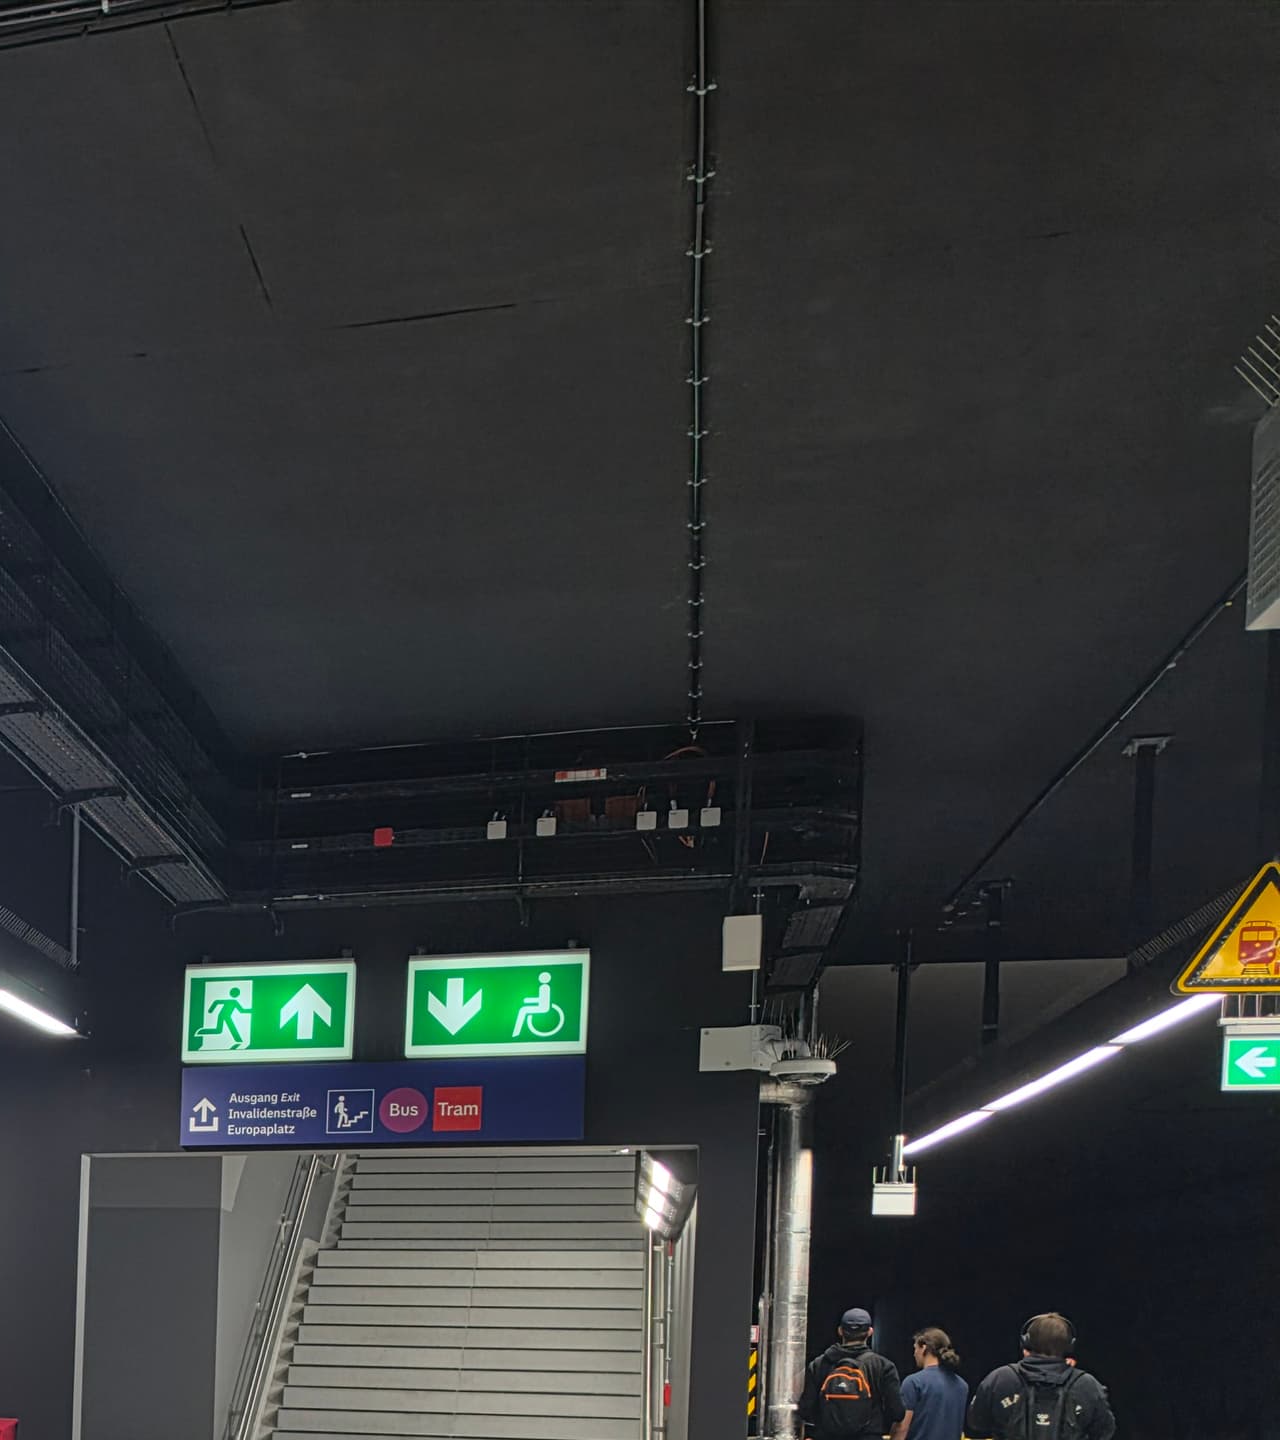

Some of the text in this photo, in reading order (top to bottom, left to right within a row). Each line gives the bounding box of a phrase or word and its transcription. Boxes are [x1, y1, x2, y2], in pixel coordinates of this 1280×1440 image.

[229, 1092, 300, 1105] Ausgang Exit
[228, 1107, 317, 1119] Invalidenstraße
[389, 1102, 418, 1117] Bus
[437, 1102, 479, 1117] Tram
[227, 1123, 296, 1136] Europaplatz
